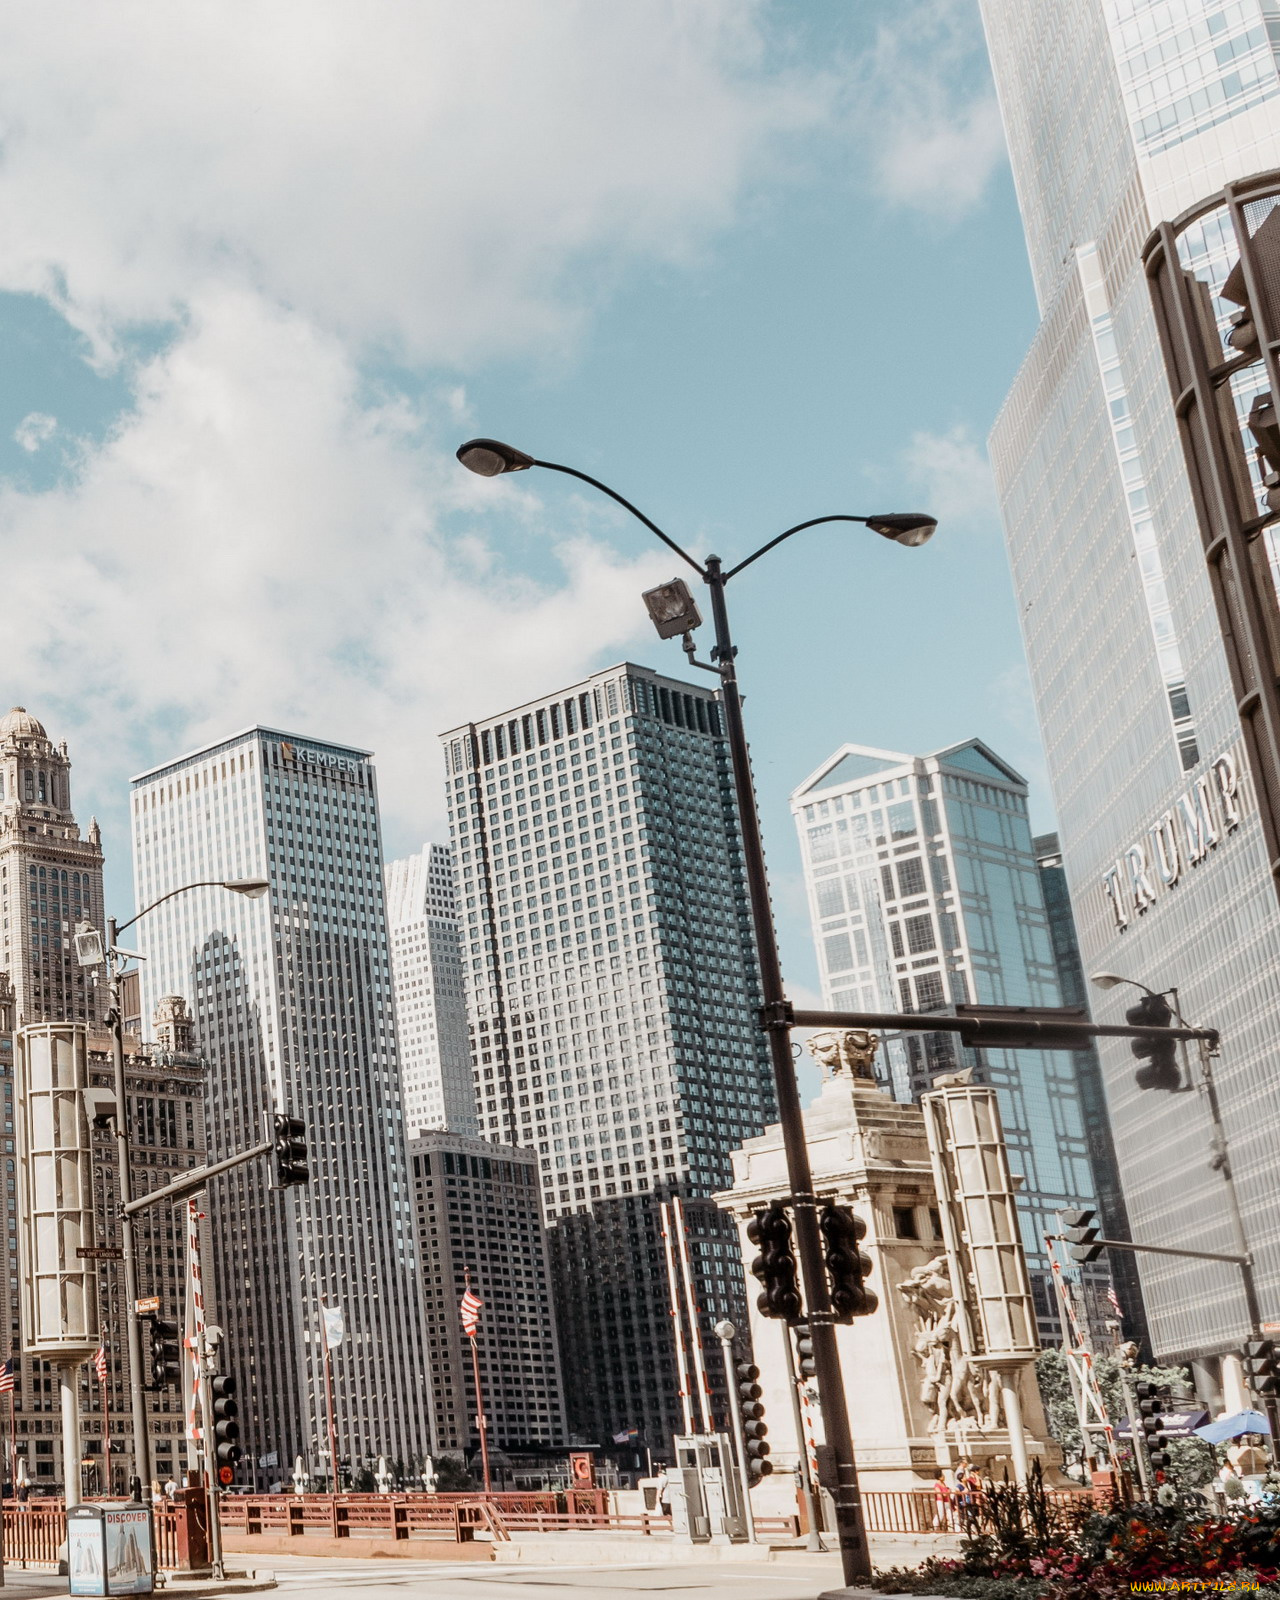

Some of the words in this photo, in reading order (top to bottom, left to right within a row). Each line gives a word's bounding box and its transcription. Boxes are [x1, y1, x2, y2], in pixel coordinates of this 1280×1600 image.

[296, 747, 356, 772] KEMPER
[1102, 752, 1239, 929] TRUMP
[107, 1512, 147, 1524] DISCOVER
